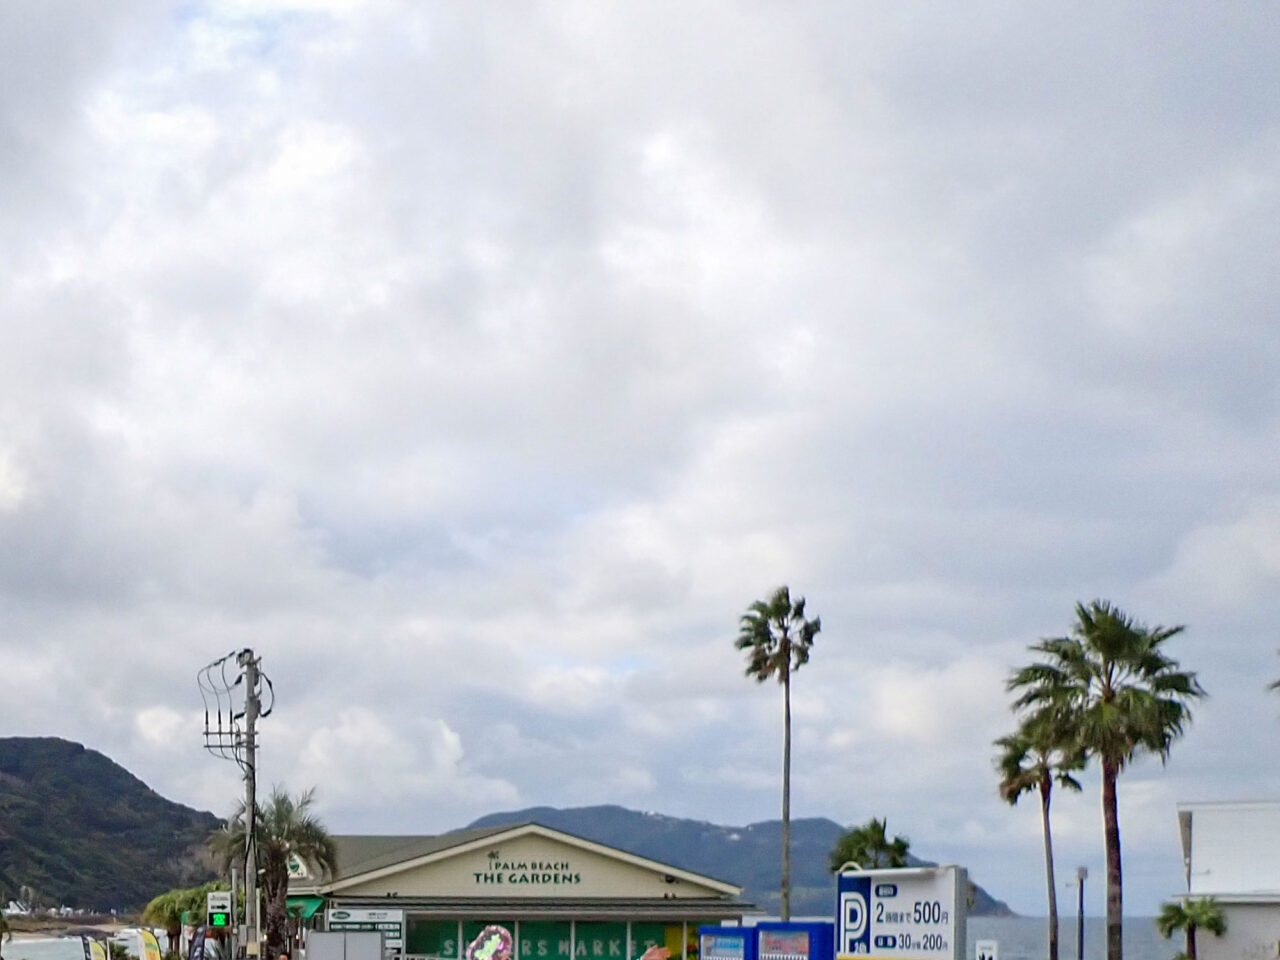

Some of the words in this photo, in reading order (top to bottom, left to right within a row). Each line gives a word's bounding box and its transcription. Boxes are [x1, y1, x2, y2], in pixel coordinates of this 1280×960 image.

[494, 861, 528, 871] PALM
[531, 861, 569, 871] BEACH
[473, 872, 503, 884] THE
[508, 872, 582, 885] GARDENS
